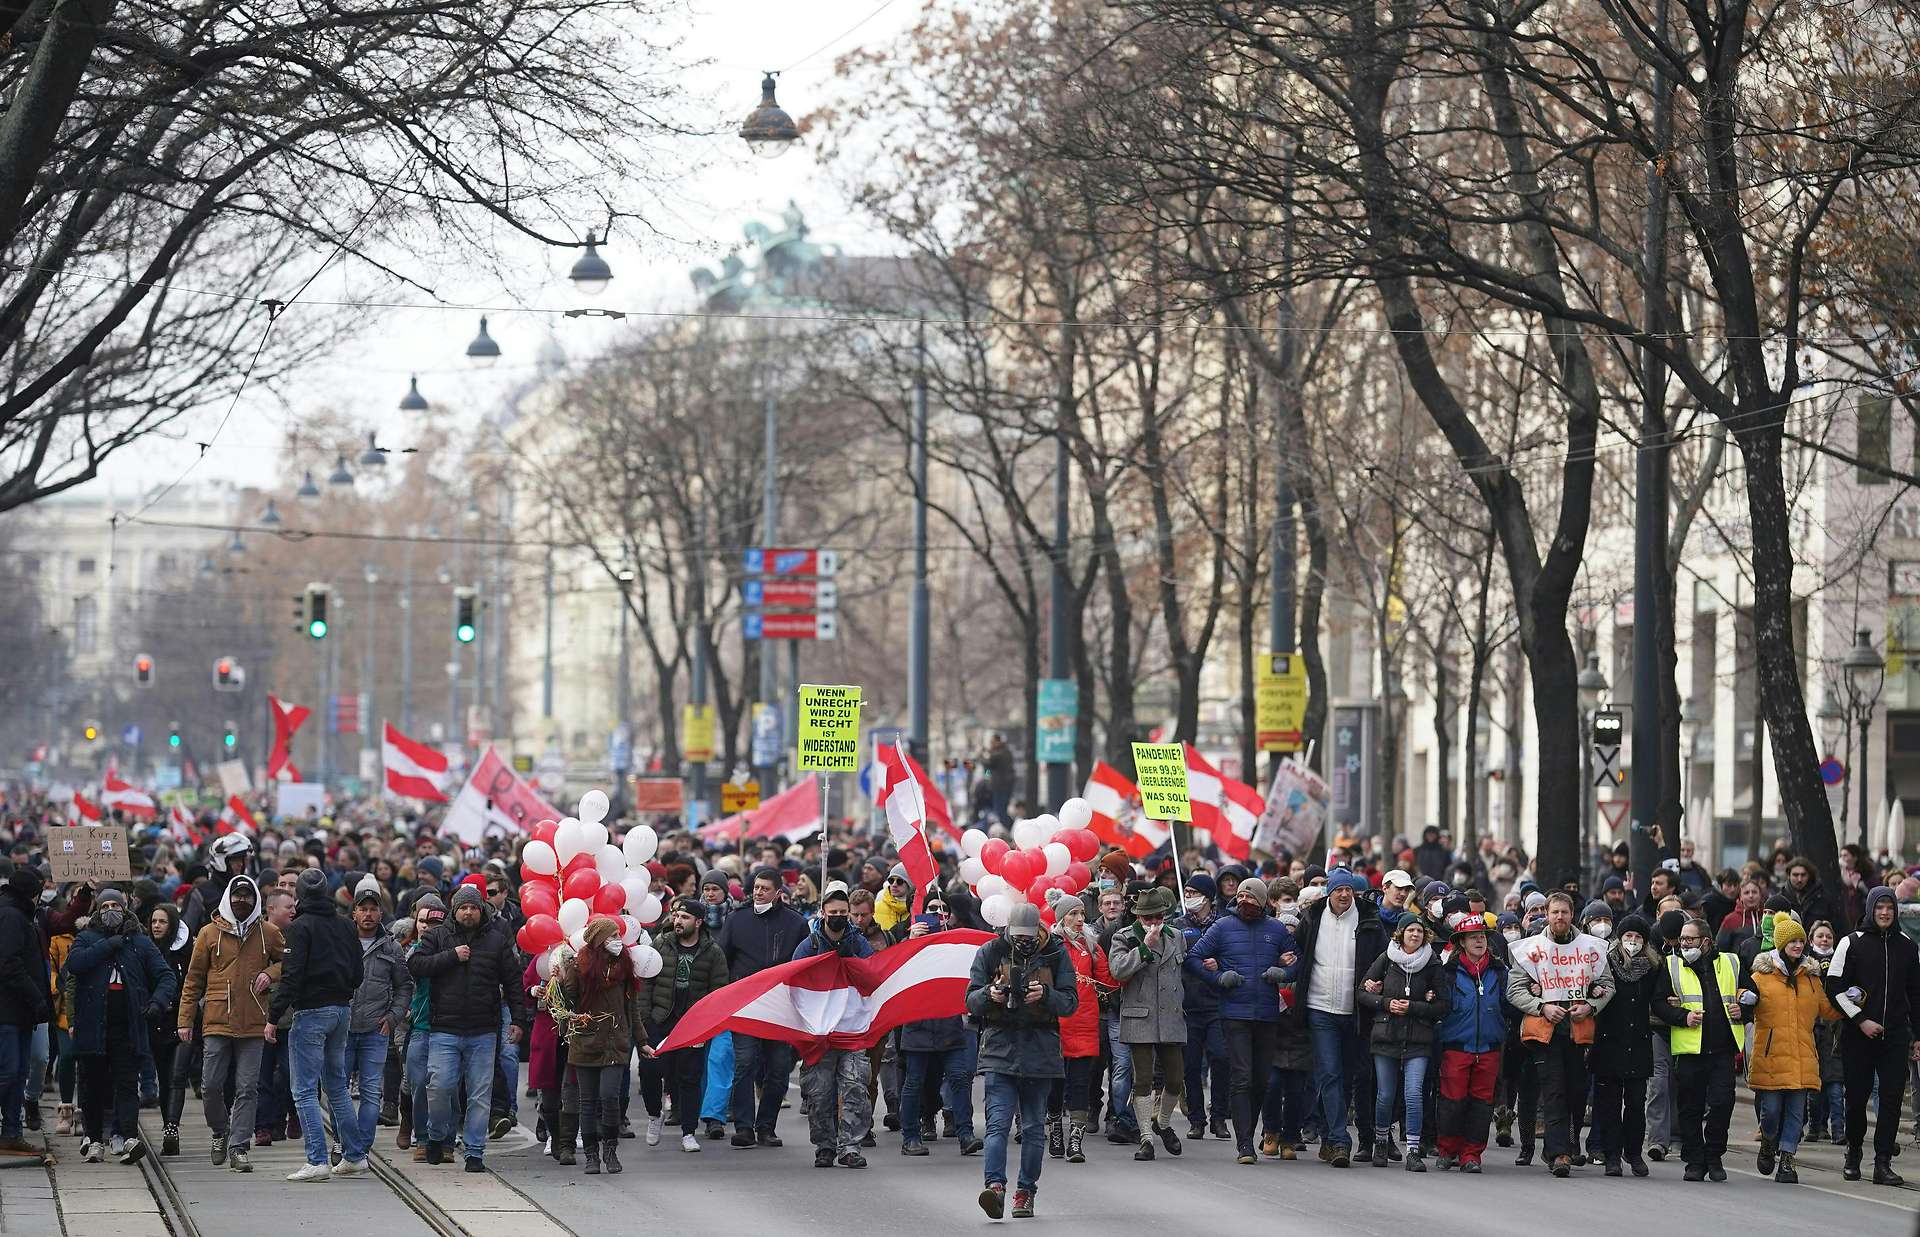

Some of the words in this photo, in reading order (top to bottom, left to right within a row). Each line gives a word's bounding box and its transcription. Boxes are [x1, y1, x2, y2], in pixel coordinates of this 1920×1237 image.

[817, 689, 846, 697] WENN
[805, 698, 859, 708] UNRECHT
[810, 709, 835, 717] WIRD
[837, 709, 851, 718] ZU
[810, 719, 853, 728] RECHT
[803, 739, 856, 753] WIDERSTAND
[1136, 748, 1181, 760] PANDEMIE?
[803, 755, 854, 767] PFLICHT!!
[1145, 791, 1165, 801] WAS
[1167, 793, 1189, 802] SOLL
[1159, 805, 1181, 815] DAS?
[89, 827, 119, 840] Kurz
